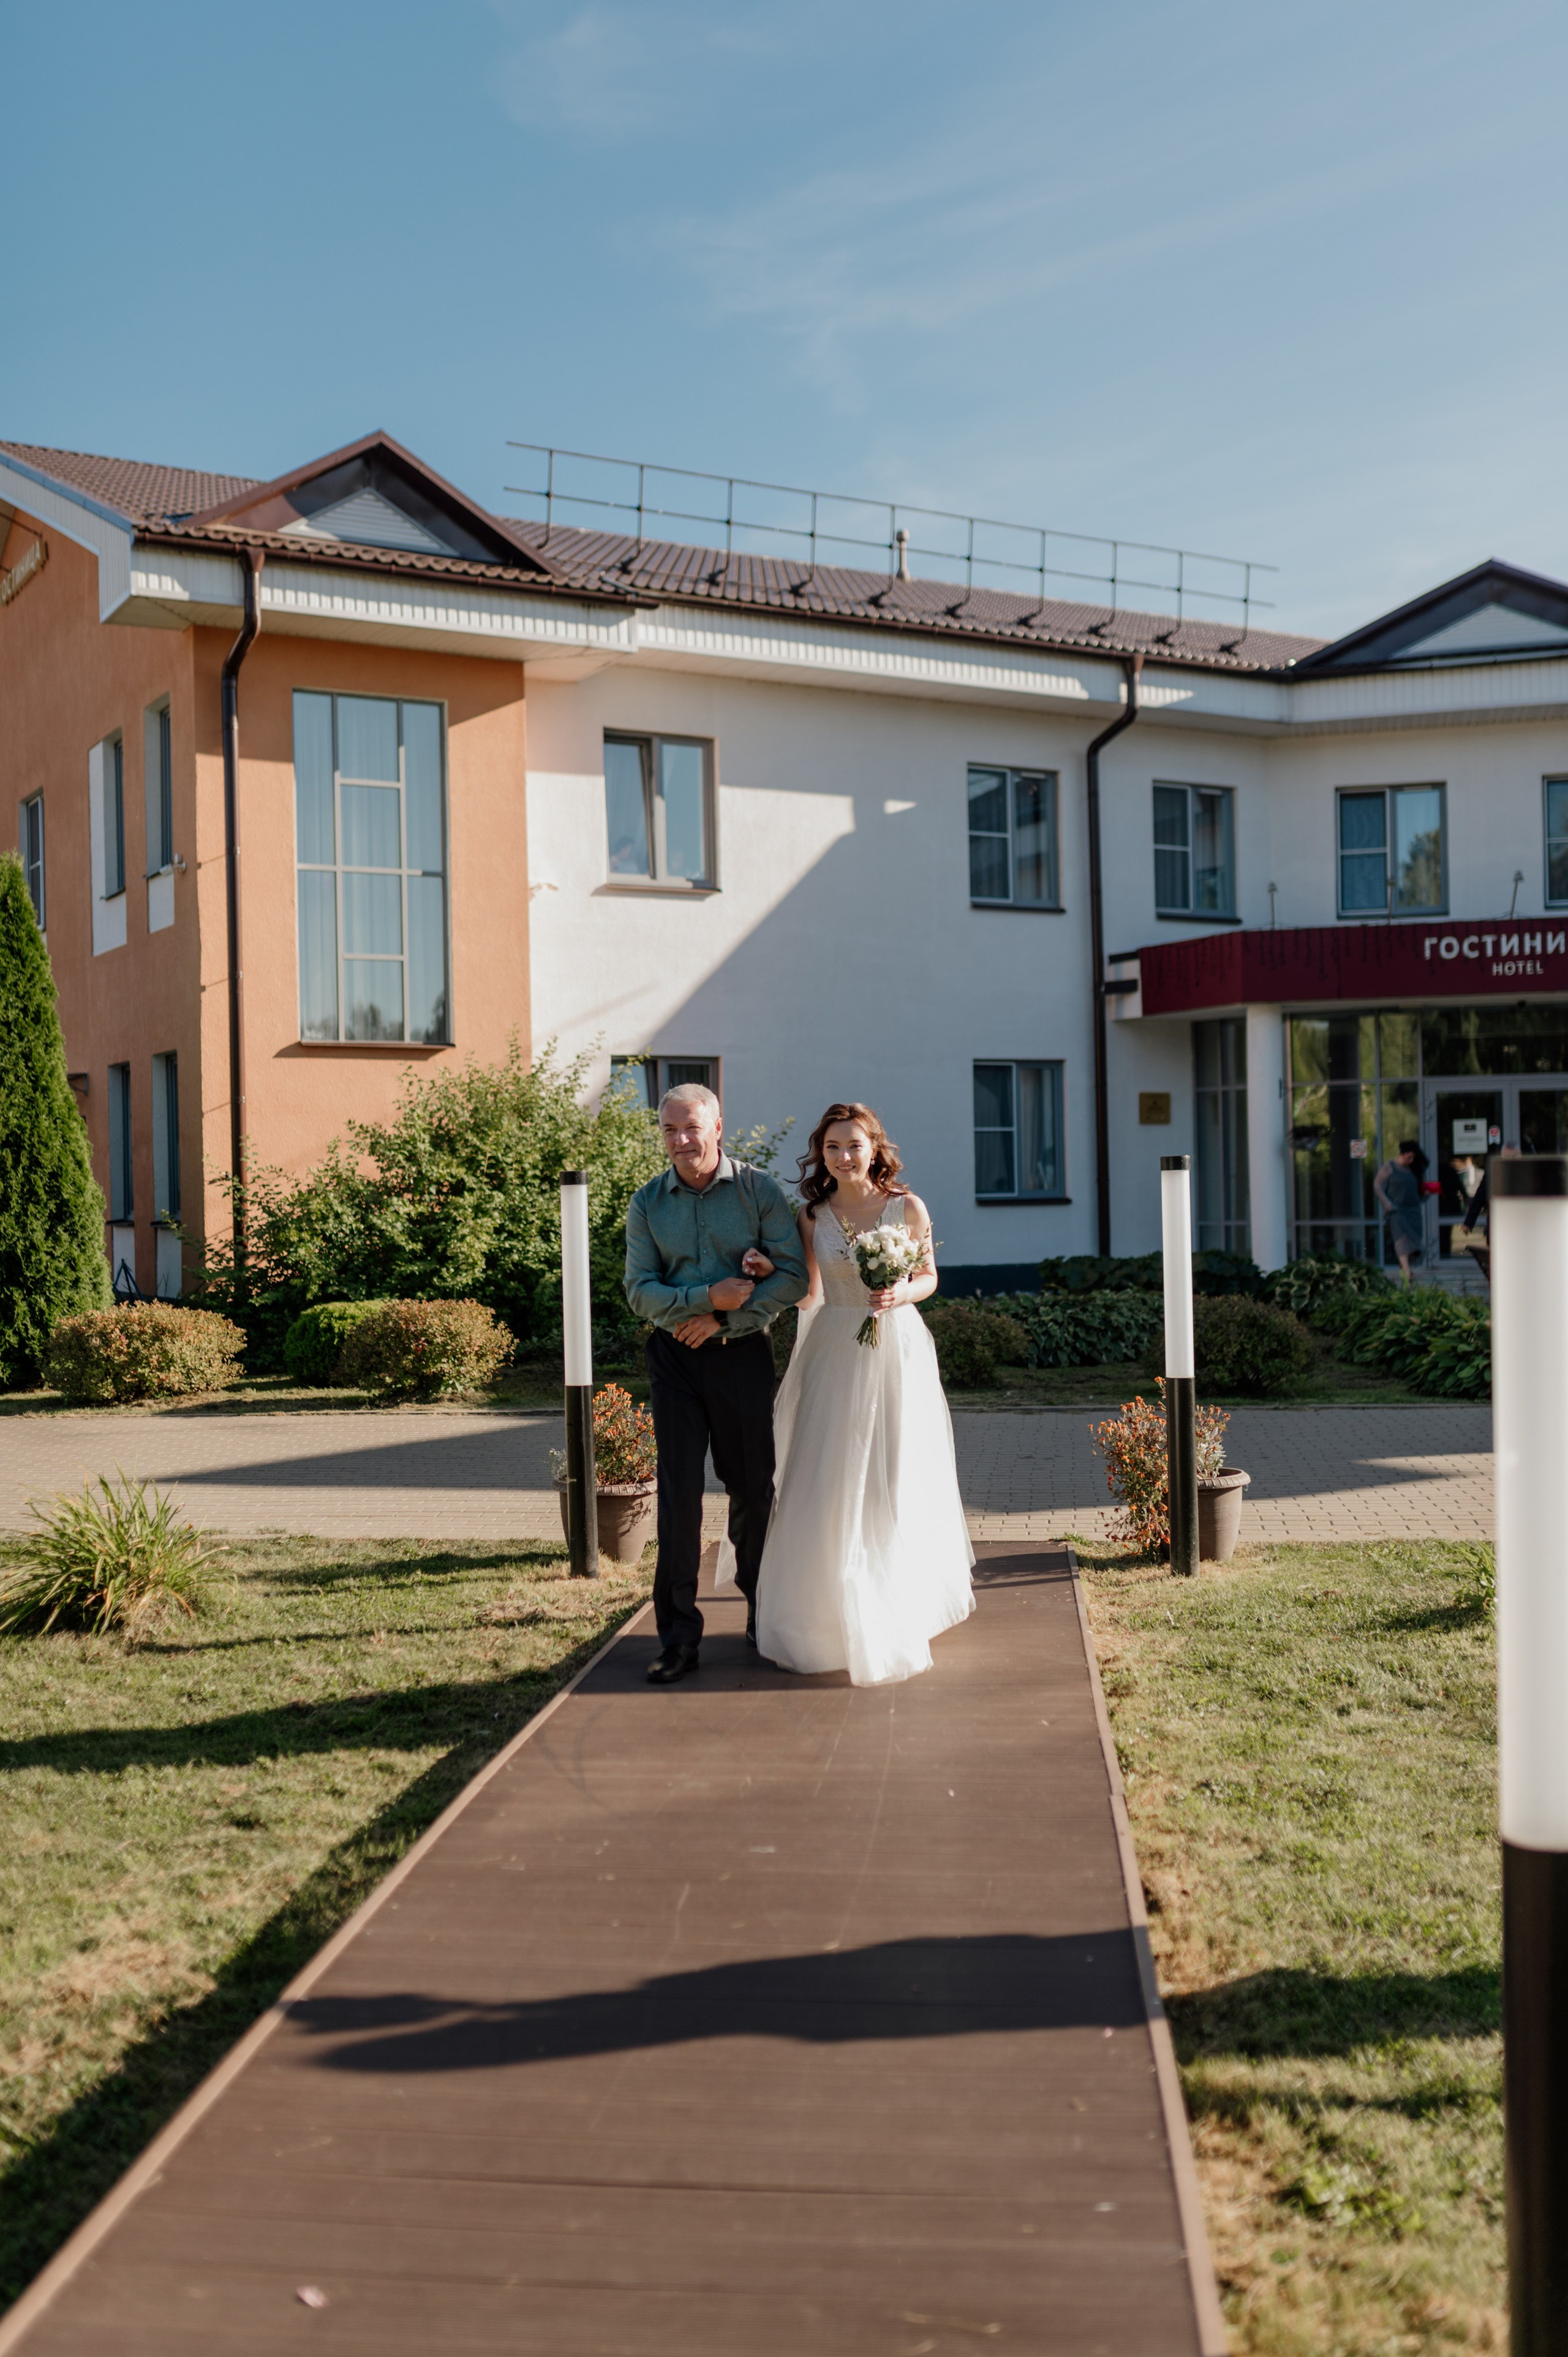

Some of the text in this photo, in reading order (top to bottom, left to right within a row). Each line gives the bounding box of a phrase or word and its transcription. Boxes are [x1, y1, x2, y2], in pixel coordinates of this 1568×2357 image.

[0, 539, 41, 602] ОСТИНИЦА
[1424, 931, 1566, 960] ГОСТИНИ
[1491, 960, 1544, 976] HOTEL
